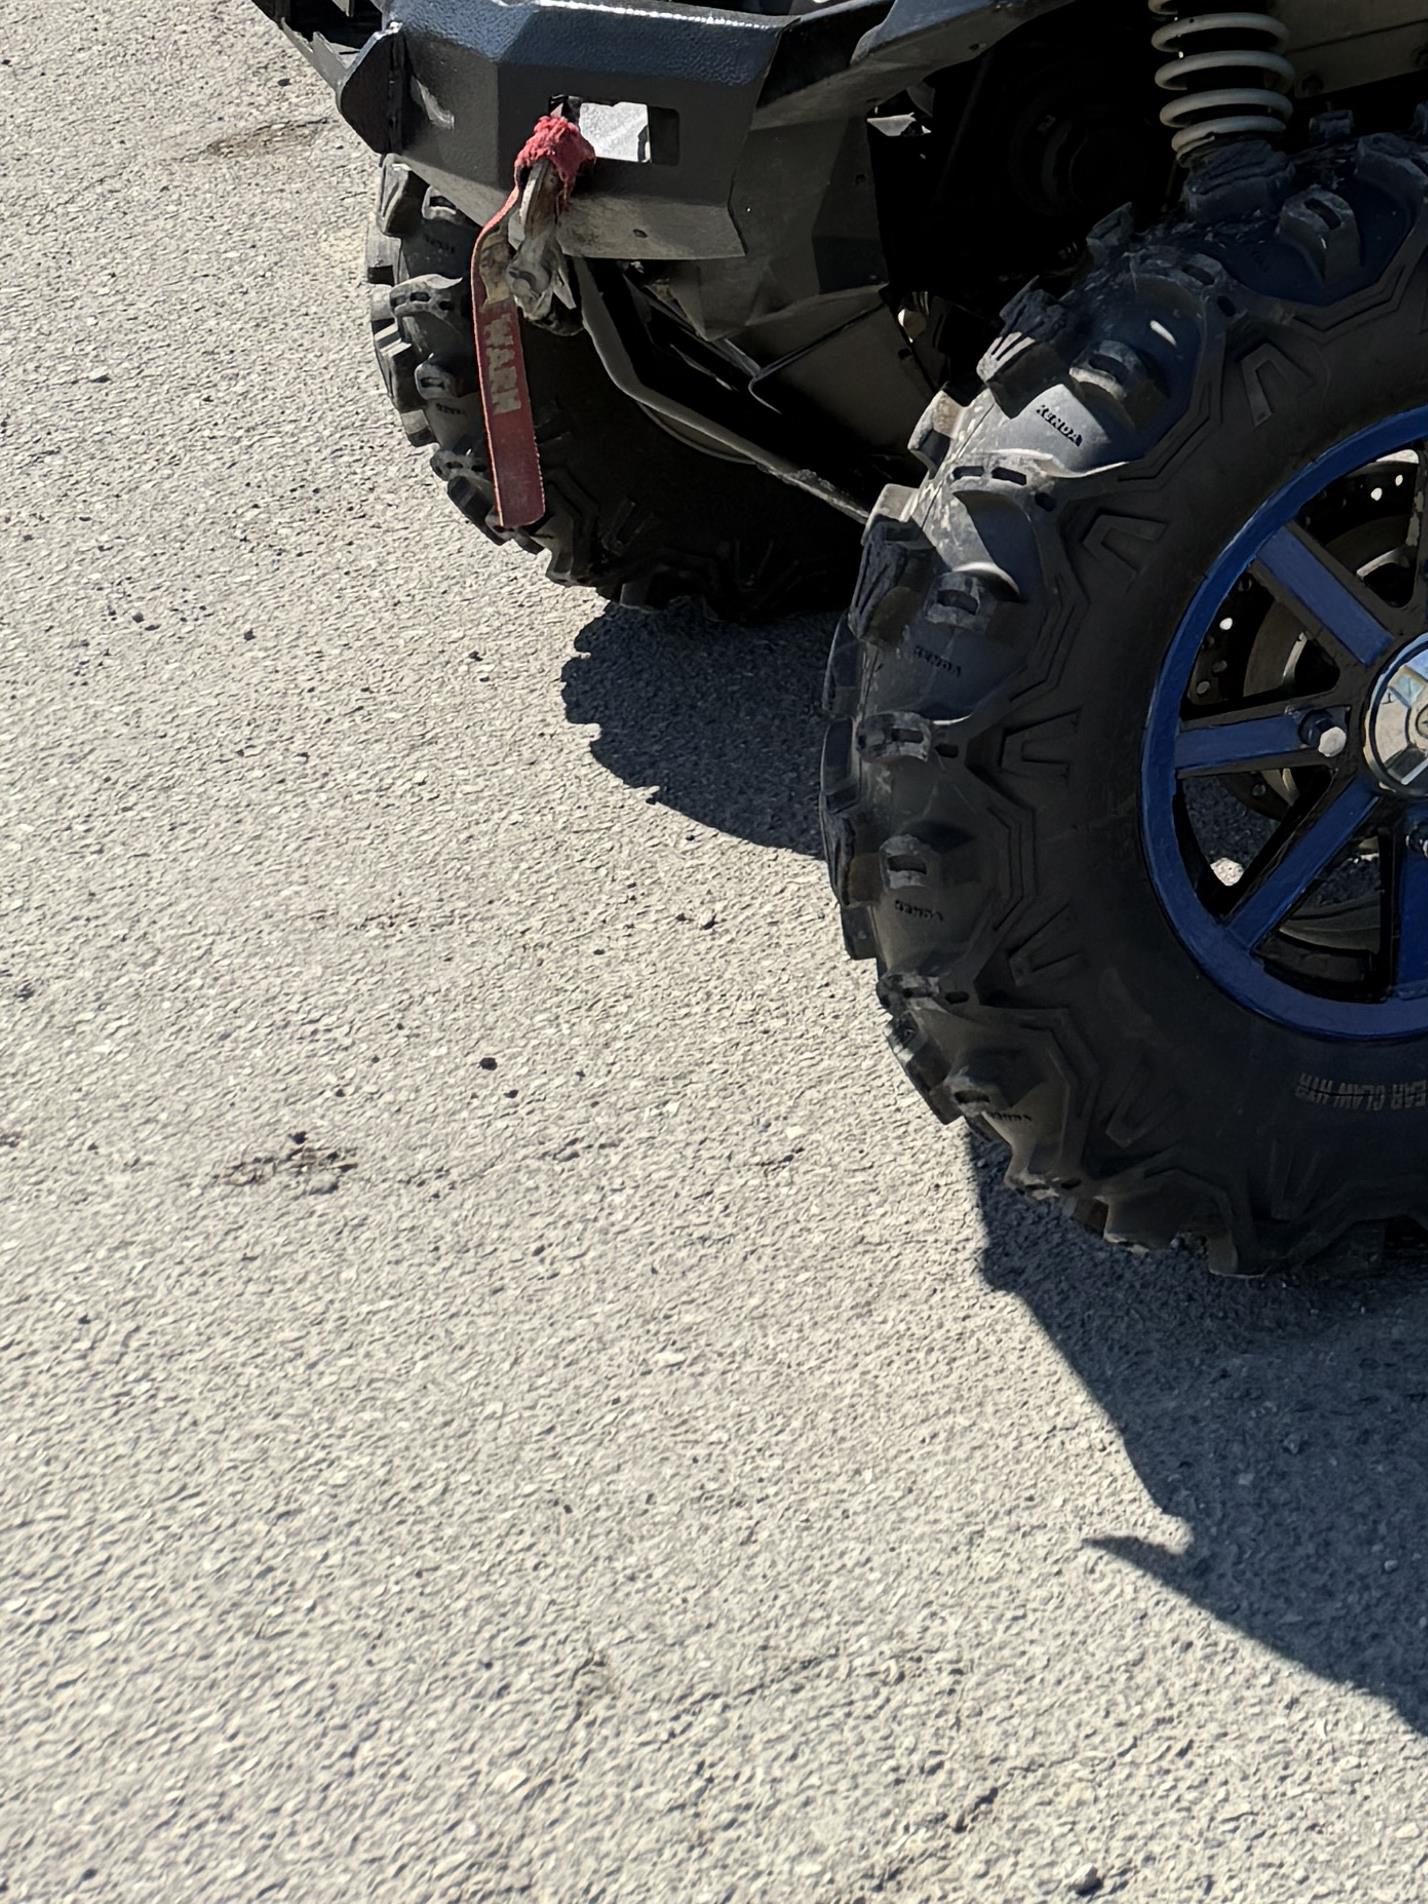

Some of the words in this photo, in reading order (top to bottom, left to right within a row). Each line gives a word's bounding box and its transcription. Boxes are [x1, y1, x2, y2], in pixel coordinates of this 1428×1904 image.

[483, 312, 523, 416] WARN
[1036, 404, 1083, 448] KENDA
[1333, 1082, 1387, 1112] CLAW
